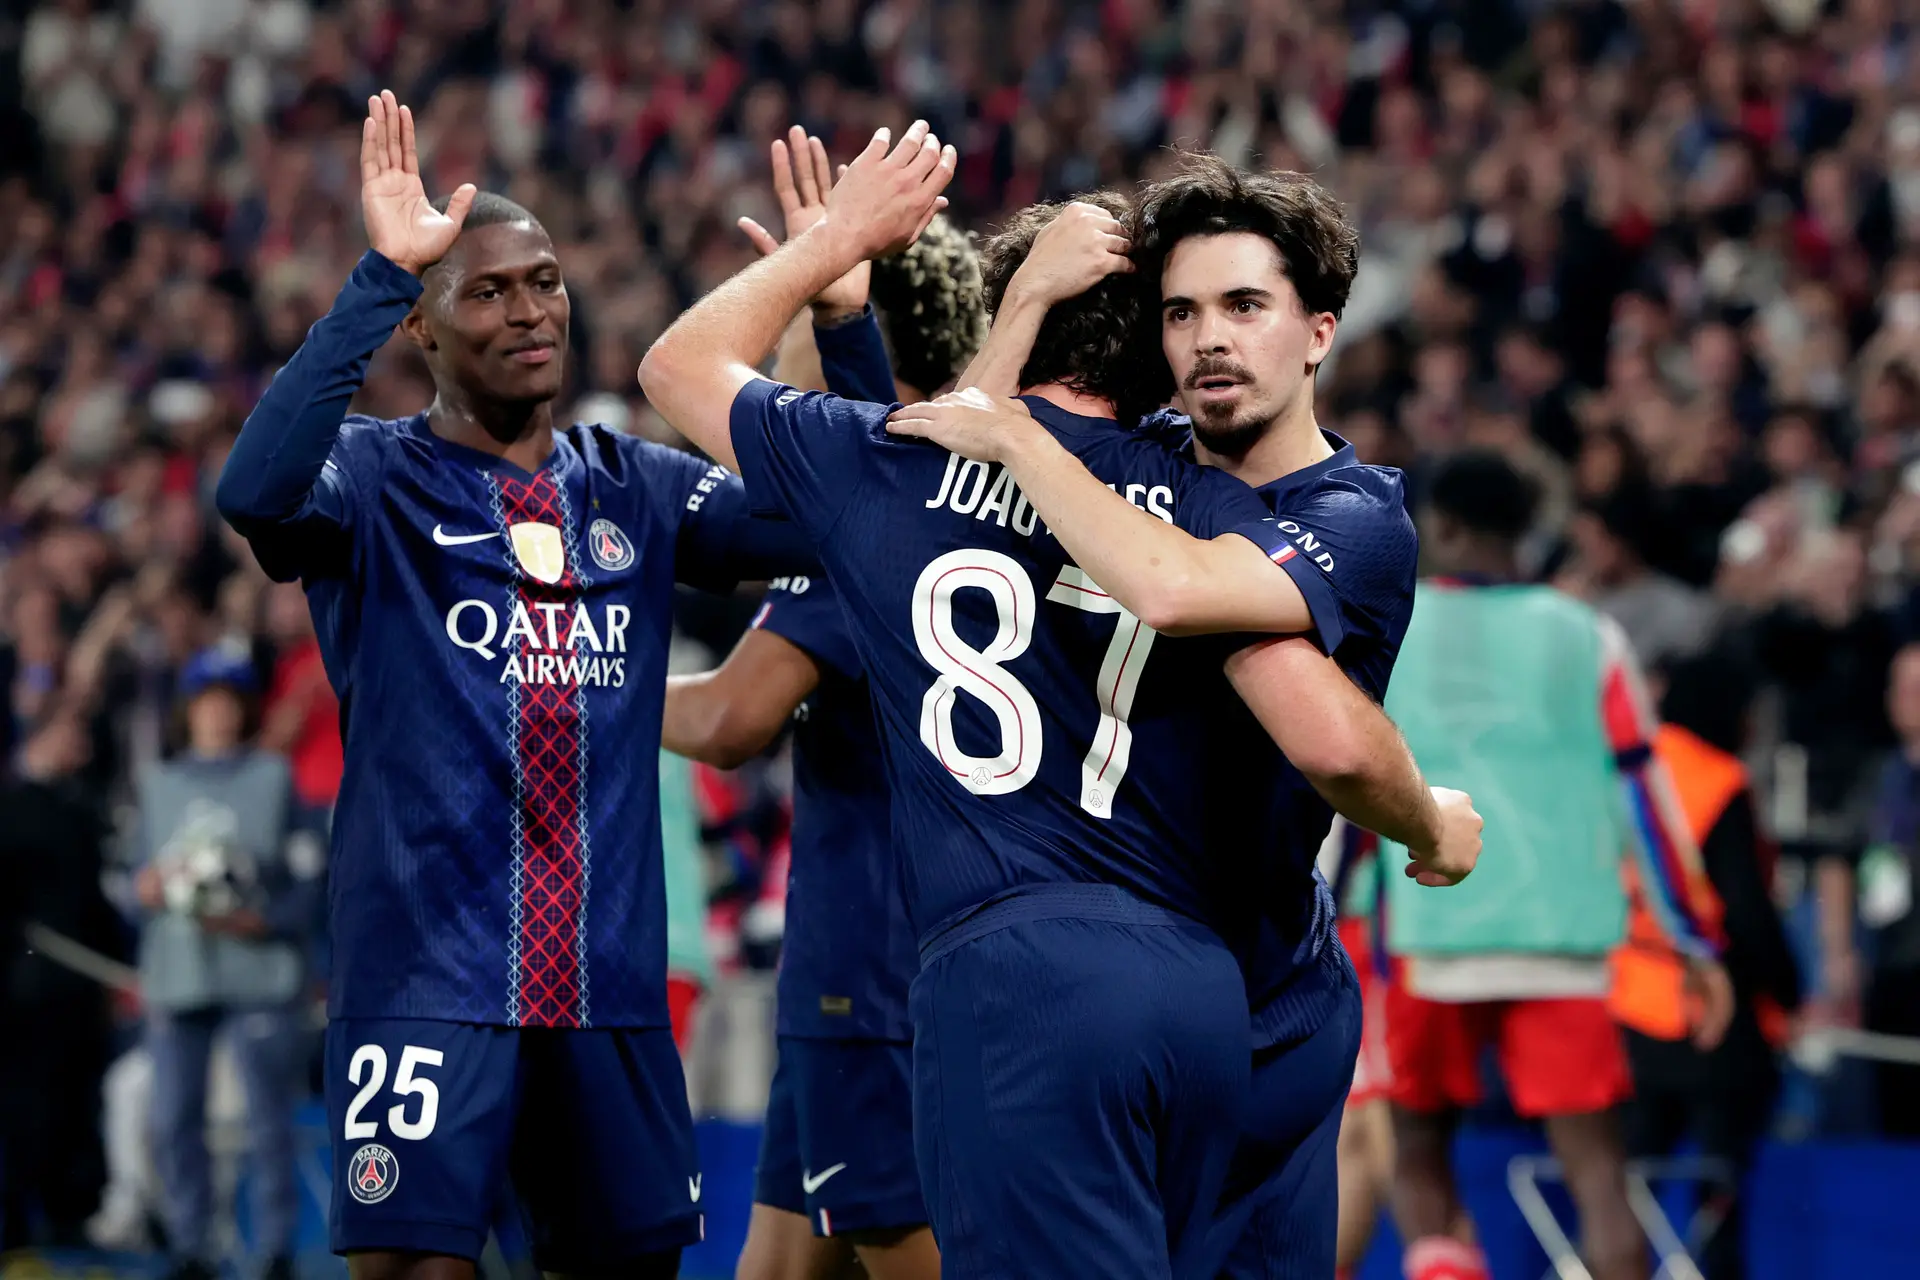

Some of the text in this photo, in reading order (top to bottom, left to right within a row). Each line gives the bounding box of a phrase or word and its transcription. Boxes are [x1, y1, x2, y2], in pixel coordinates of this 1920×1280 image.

[445, 599, 631, 661] QATAR
[500, 654, 625, 688] AIRWAYS
[911, 548, 1156, 820] 87
[344, 1044, 444, 1140] 25
[356, 1147, 391, 1163] PARIS
